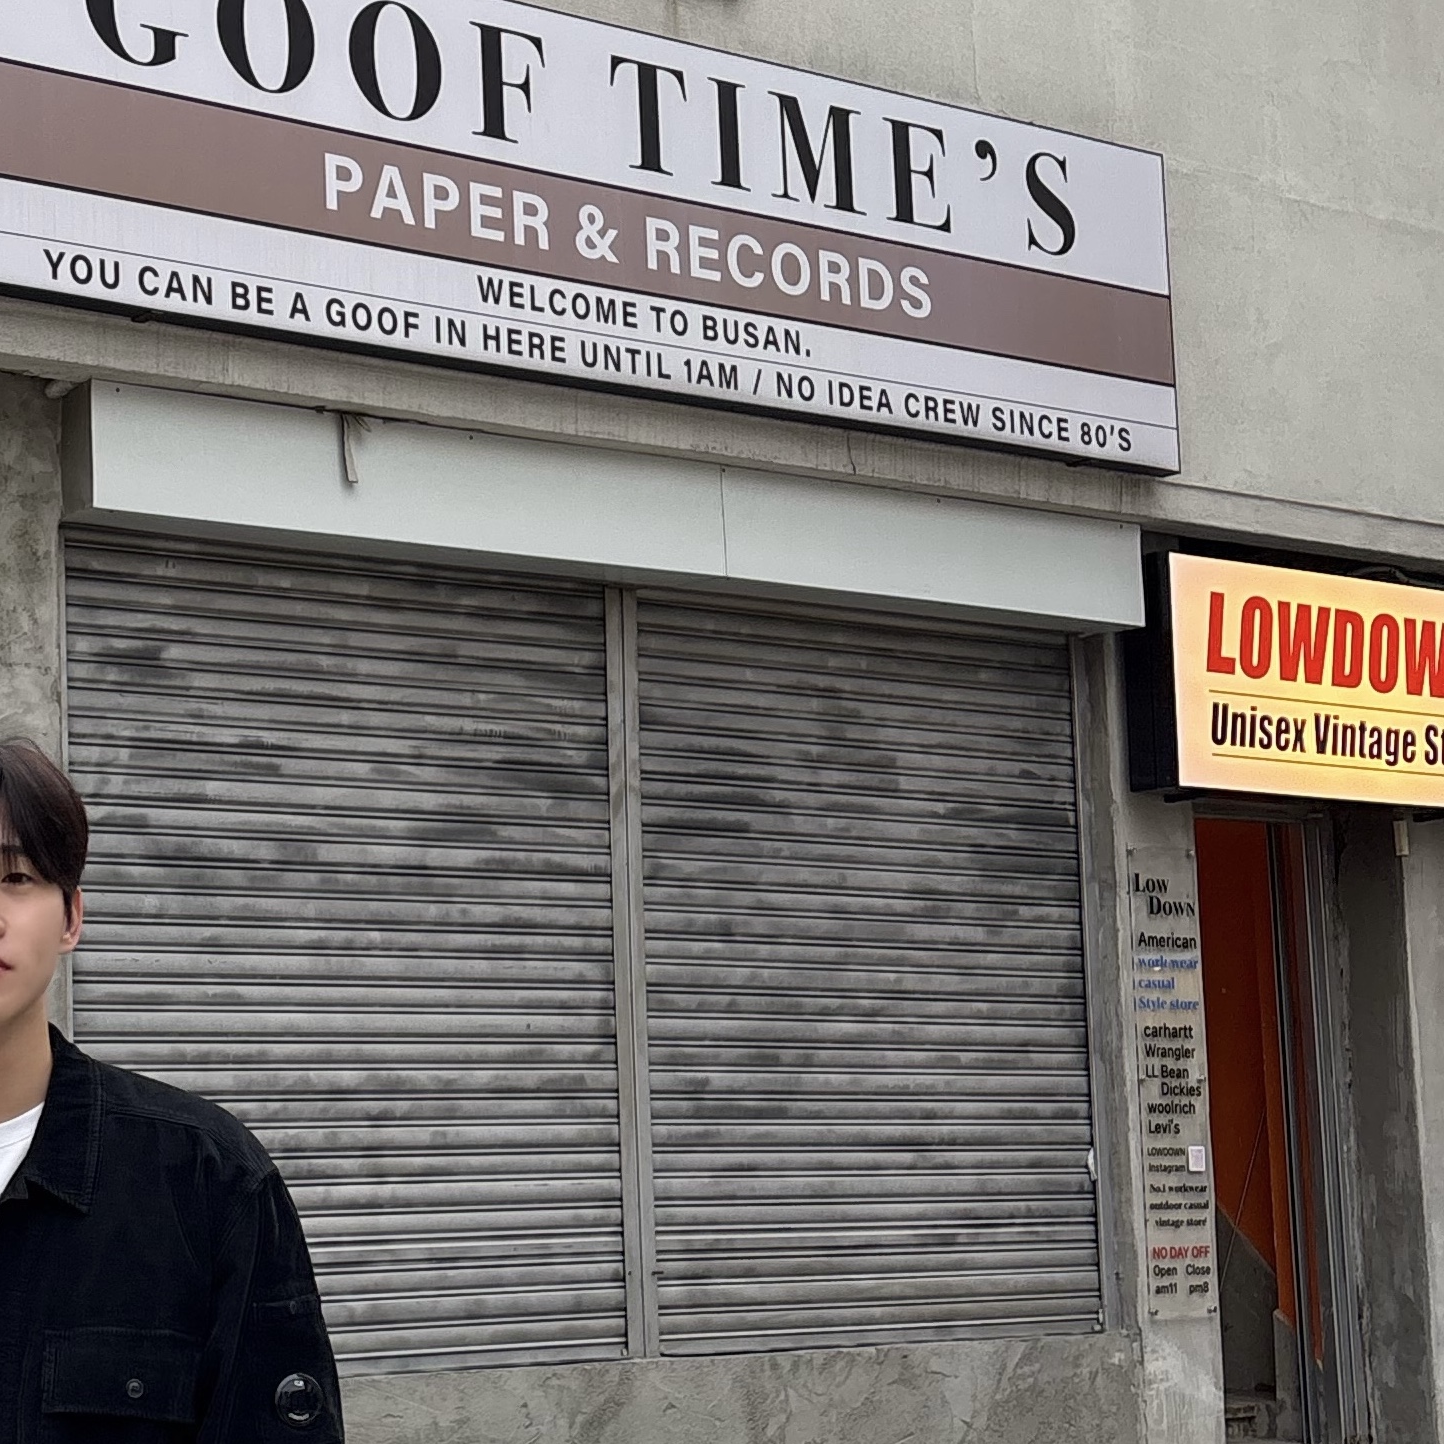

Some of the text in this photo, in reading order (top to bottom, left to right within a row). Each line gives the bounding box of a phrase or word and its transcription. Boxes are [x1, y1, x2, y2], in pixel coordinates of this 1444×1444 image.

[609, 53, 1076, 257] TIME'S
[323, 152, 934, 319] PAPER & RECORDS
[476, 274, 812, 358] WELCOME TO BUSAN.
[43, 248, 120, 290] YOU
[137, 264, 213, 306] CAN
[230, 282, 274, 316] BE
[289, 290, 311, 323] A
[325, 297, 421, 339] GOOF
[435, 317, 467, 349] IN
[482, 324, 567, 365] HERE
[580, 338, 671, 381] UNTIL
[682, 358, 739, 393] 1AM
[752, 369, 763, 395] /
[775, 372, 815, 403] NO
[828, 379, 891, 416] IDEA
[904, 393, 980, 430] CREW
[992, 406, 1070, 443] SINCE
[1211, 701, 1444, 767] Unisex Vintage S
[1138, 931, 1197, 950] American
[1138, 977, 1175, 989] casual
[1138, 995, 1200, 1013] Style store
[1143, 1022, 1194, 1040] carhartt
[1144, 1043, 1196, 1061] Wrangler
[1161, 1064, 1189, 1079] Bean
[1161, 1081, 1202, 1097] Dickies
[1147, 1100, 1196, 1115] woolrich
[1147, 1147, 1186, 1157] LOWDOWN
[1148, 1162, 1186, 1174] Instagram
[1152, 1245, 1211, 1260] NO DAY OFF
[1153, 1263, 1212, 1279] Open Close
[1155, 1282, 1178, 1295] am11
